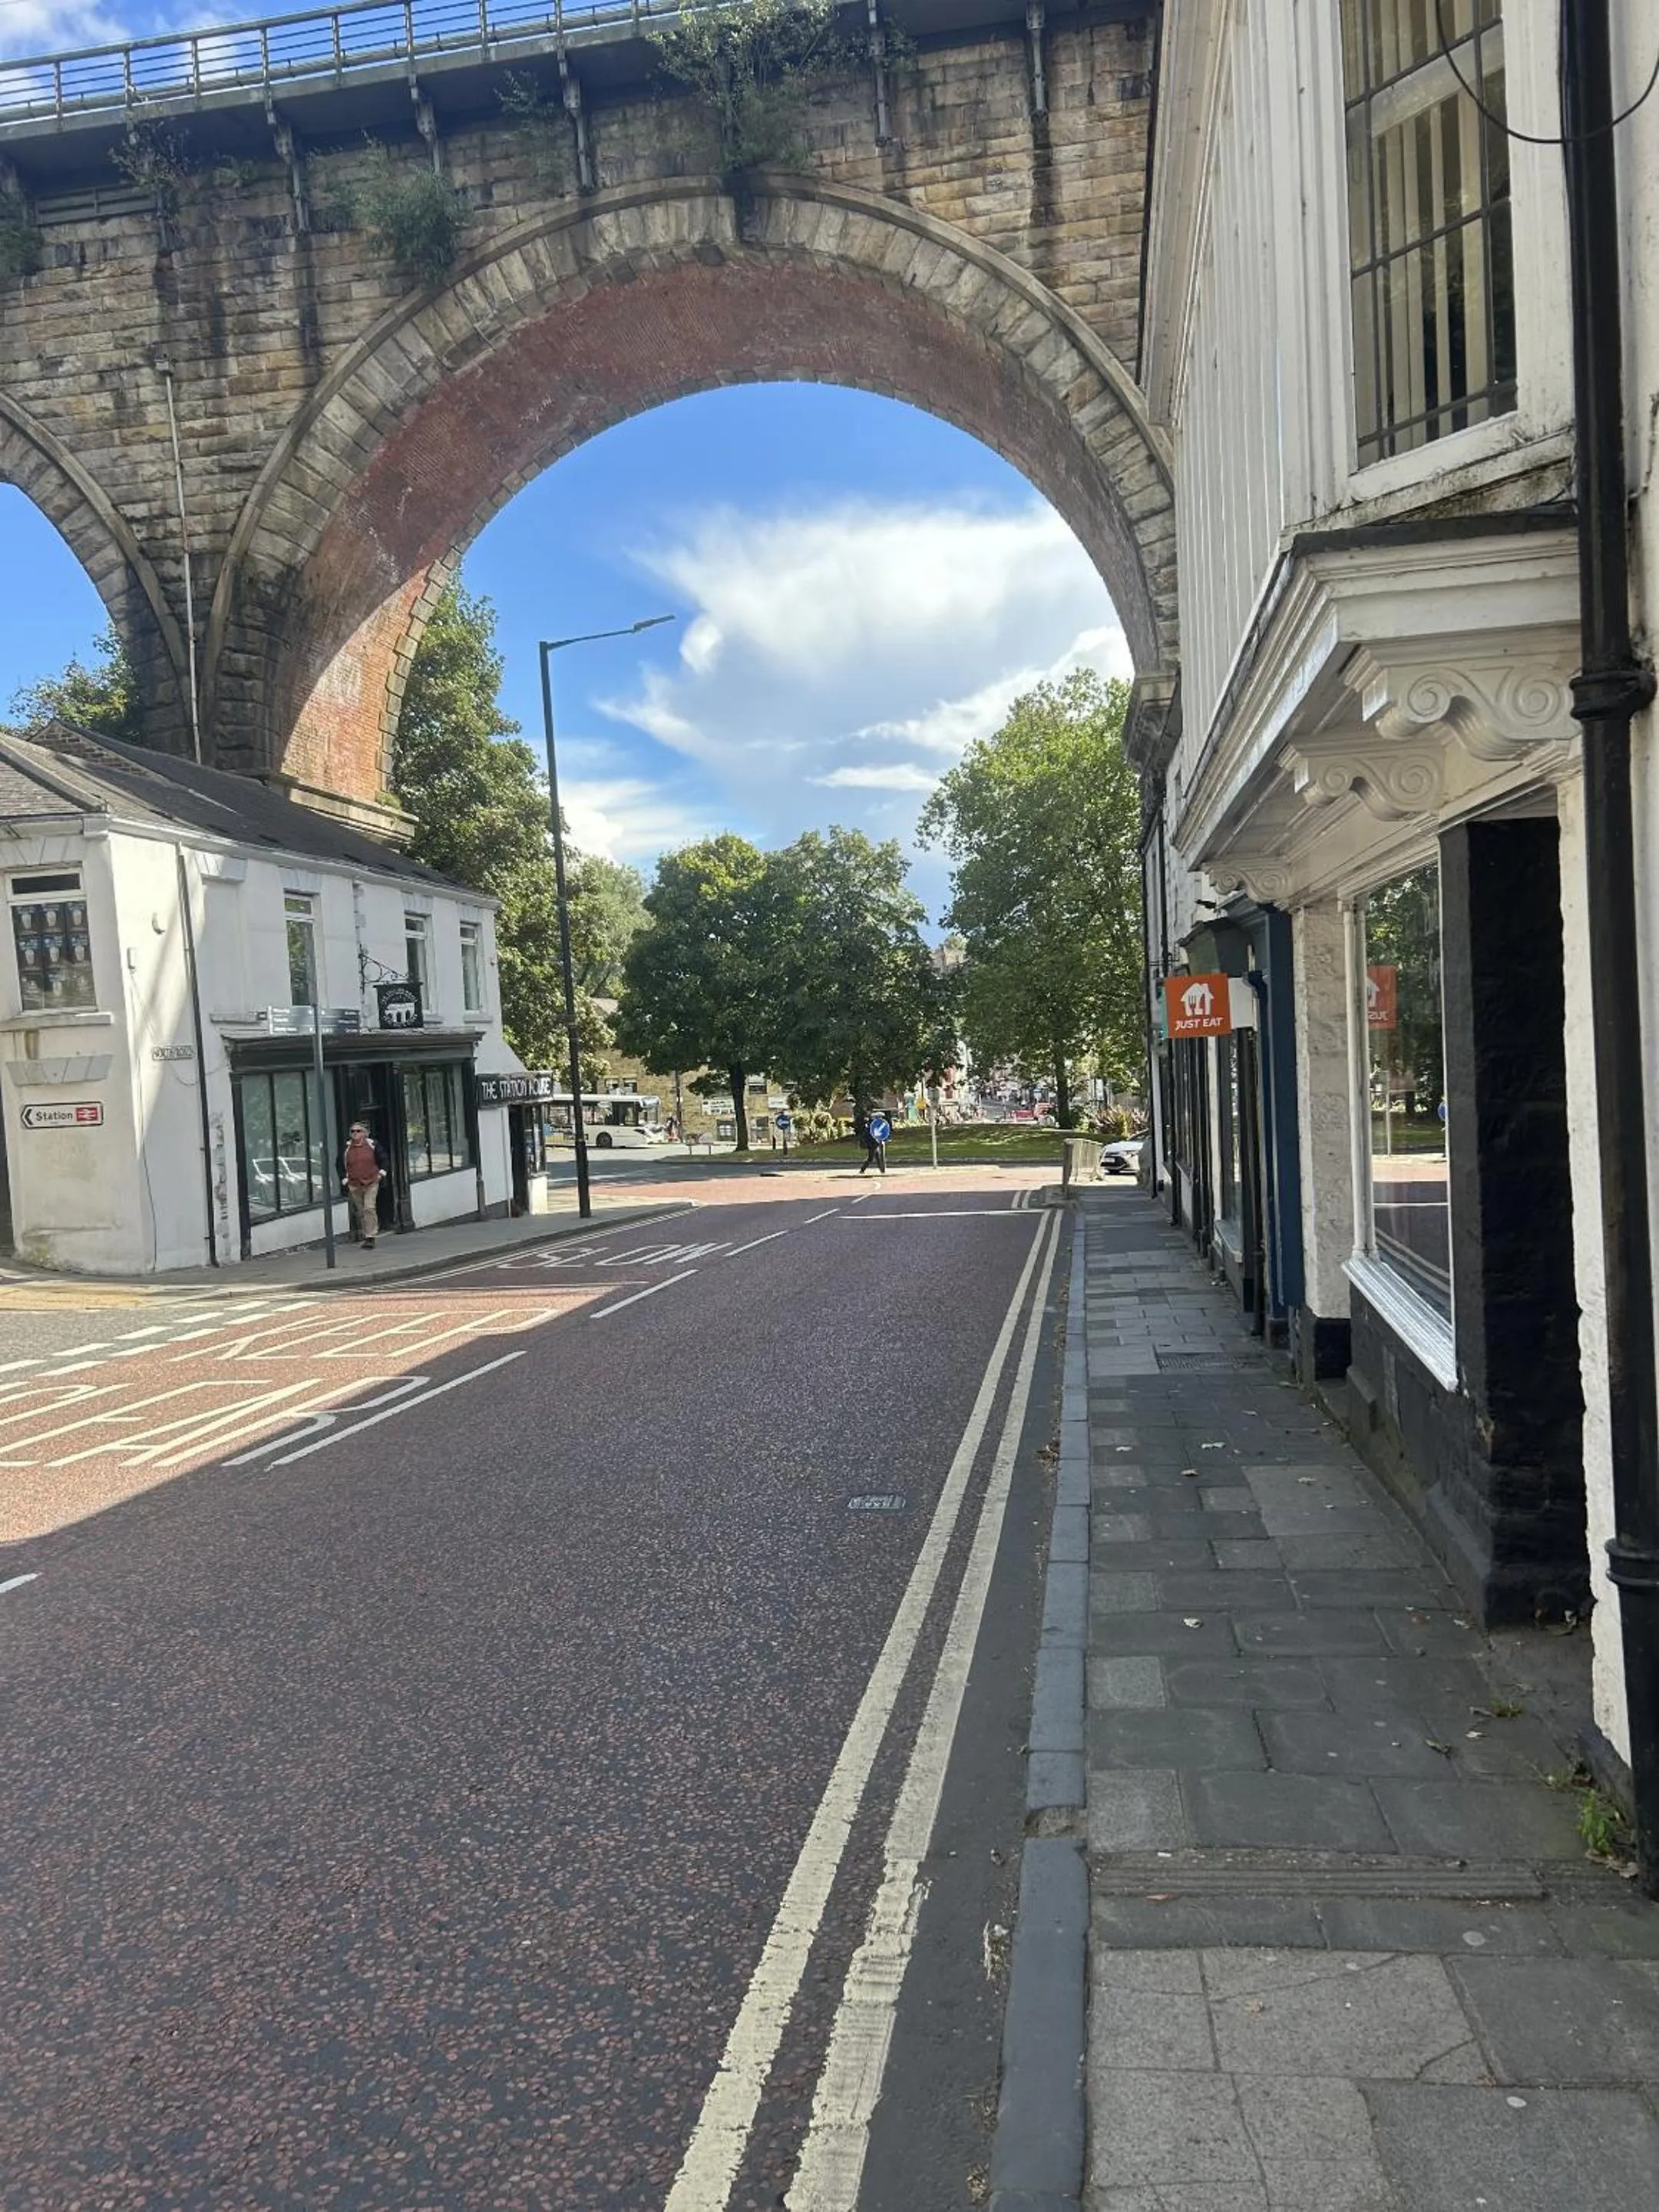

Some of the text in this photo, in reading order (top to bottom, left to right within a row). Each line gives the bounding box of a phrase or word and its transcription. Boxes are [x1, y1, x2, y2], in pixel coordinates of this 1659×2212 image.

[1175, 1017, 1224, 1030] JUST EAT
[481, 1076, 551, 1099] THE STATION HOUSE
[35, 1111, 73, 1121] Station
[497, 1242, 733, 1268] SLOW
[165, 1308, 558, 1362] KEEP
[0, 1376, 431, 1466] EAR
